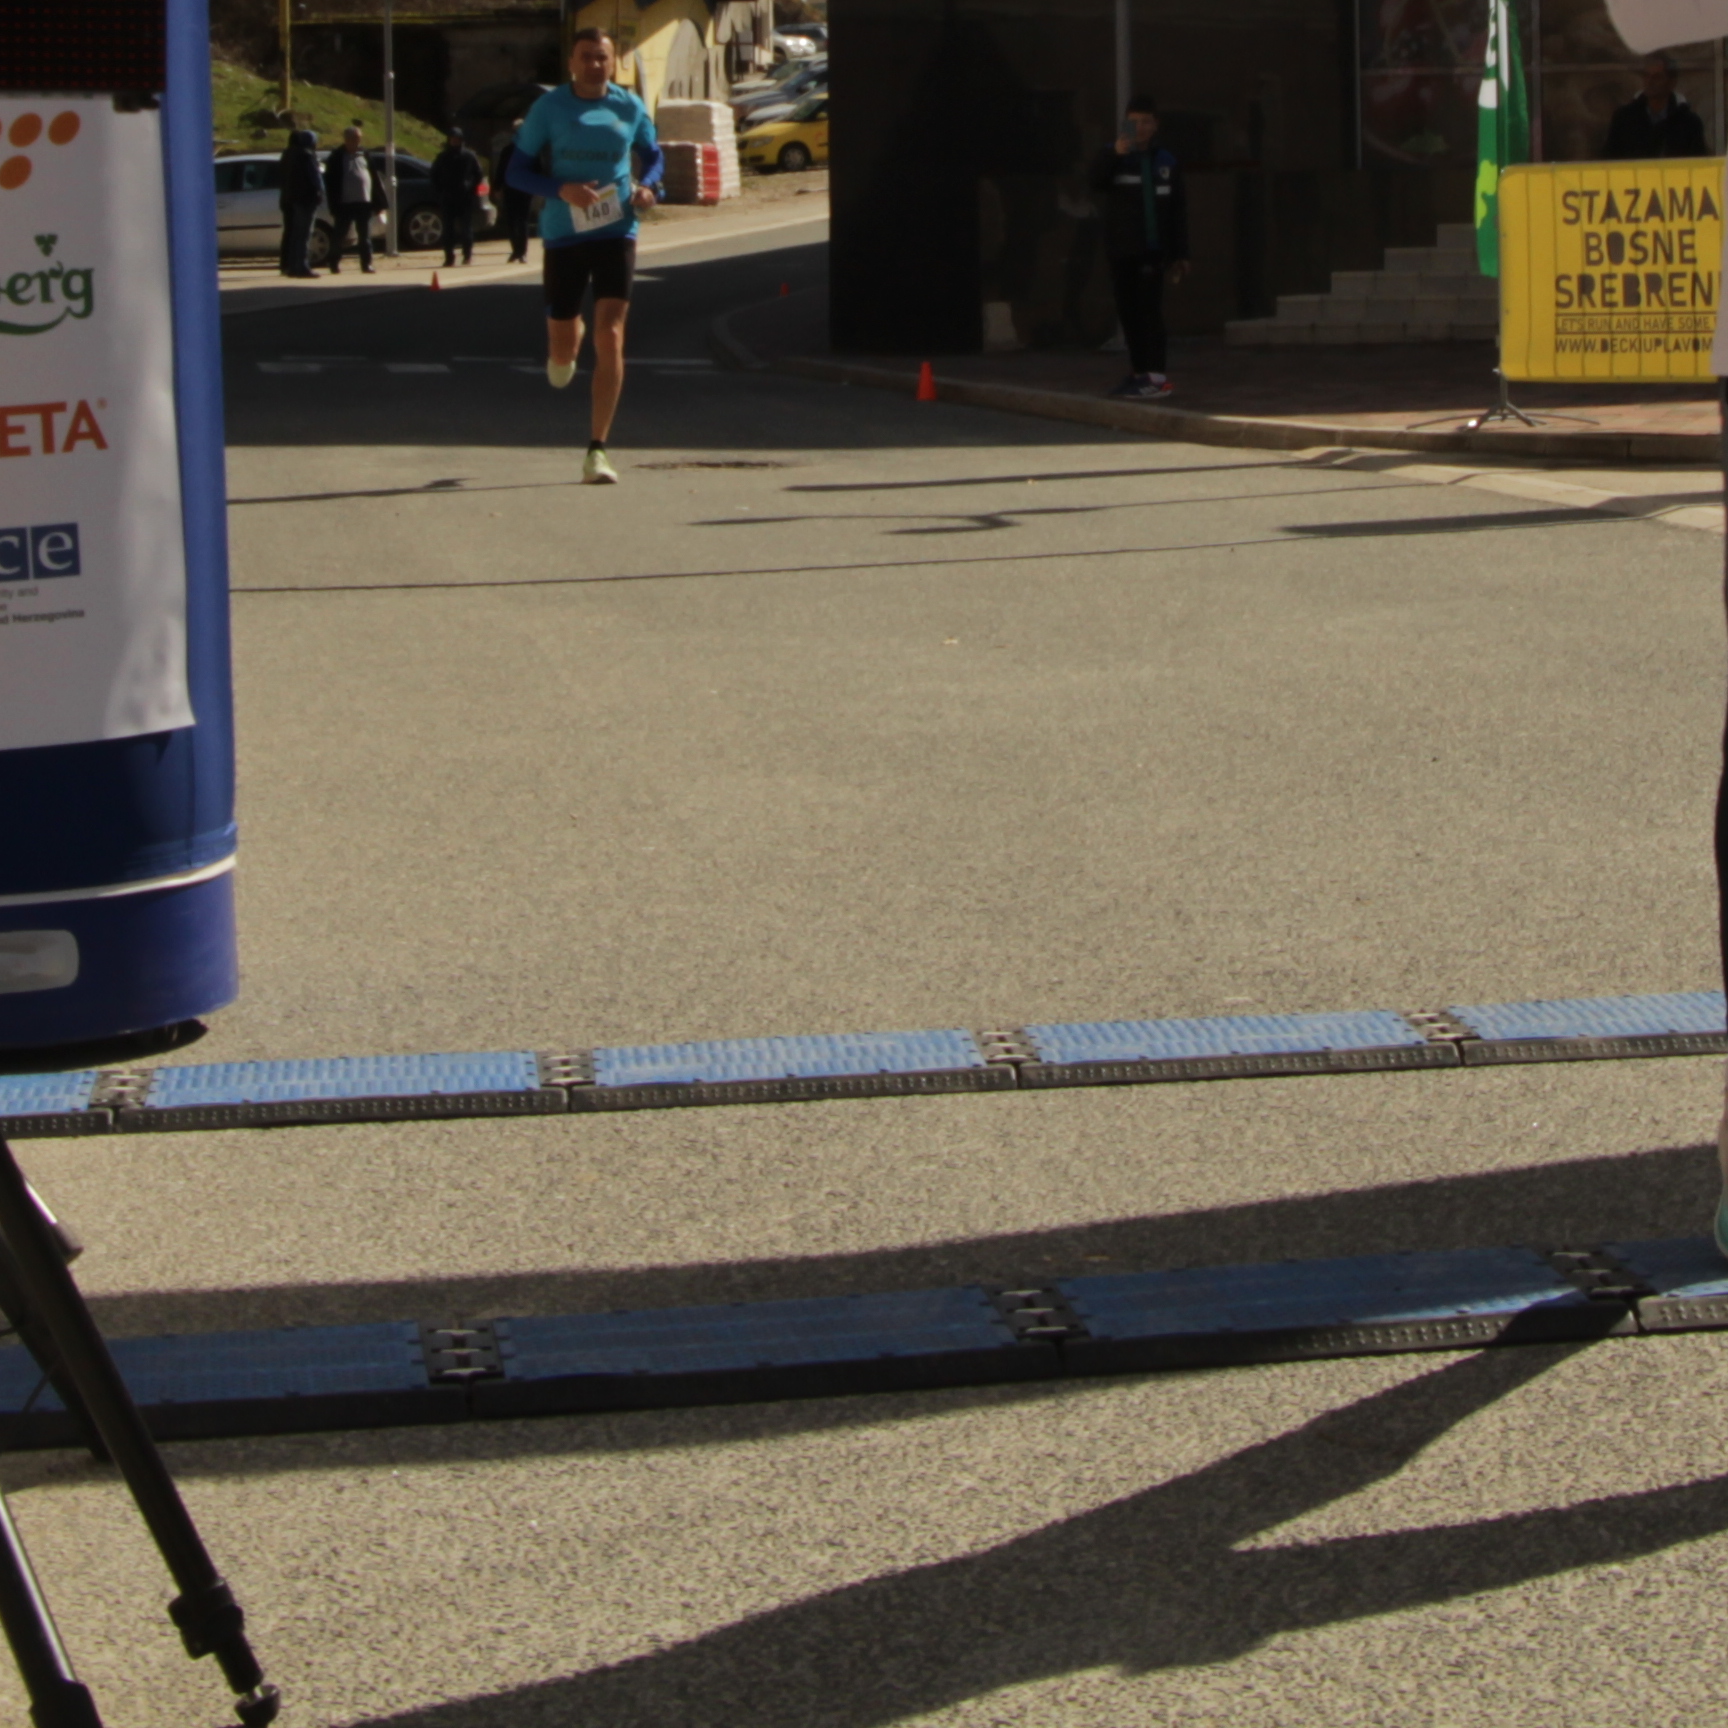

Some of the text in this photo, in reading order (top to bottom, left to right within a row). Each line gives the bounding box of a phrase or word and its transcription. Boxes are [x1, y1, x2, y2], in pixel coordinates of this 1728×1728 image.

[1561, 186, 1721, 226] STAZAMA
[1585, 229, 1698, 267] BOSNE
[1555, 271, 1717, 310] SREBREN
[1588, 317, 1611, 331] RUN
[1616, 316, 1641, 330] AND
[1644, 315, 1674, 329] HAVE
[1678, 314, 1711, 328] SOME
